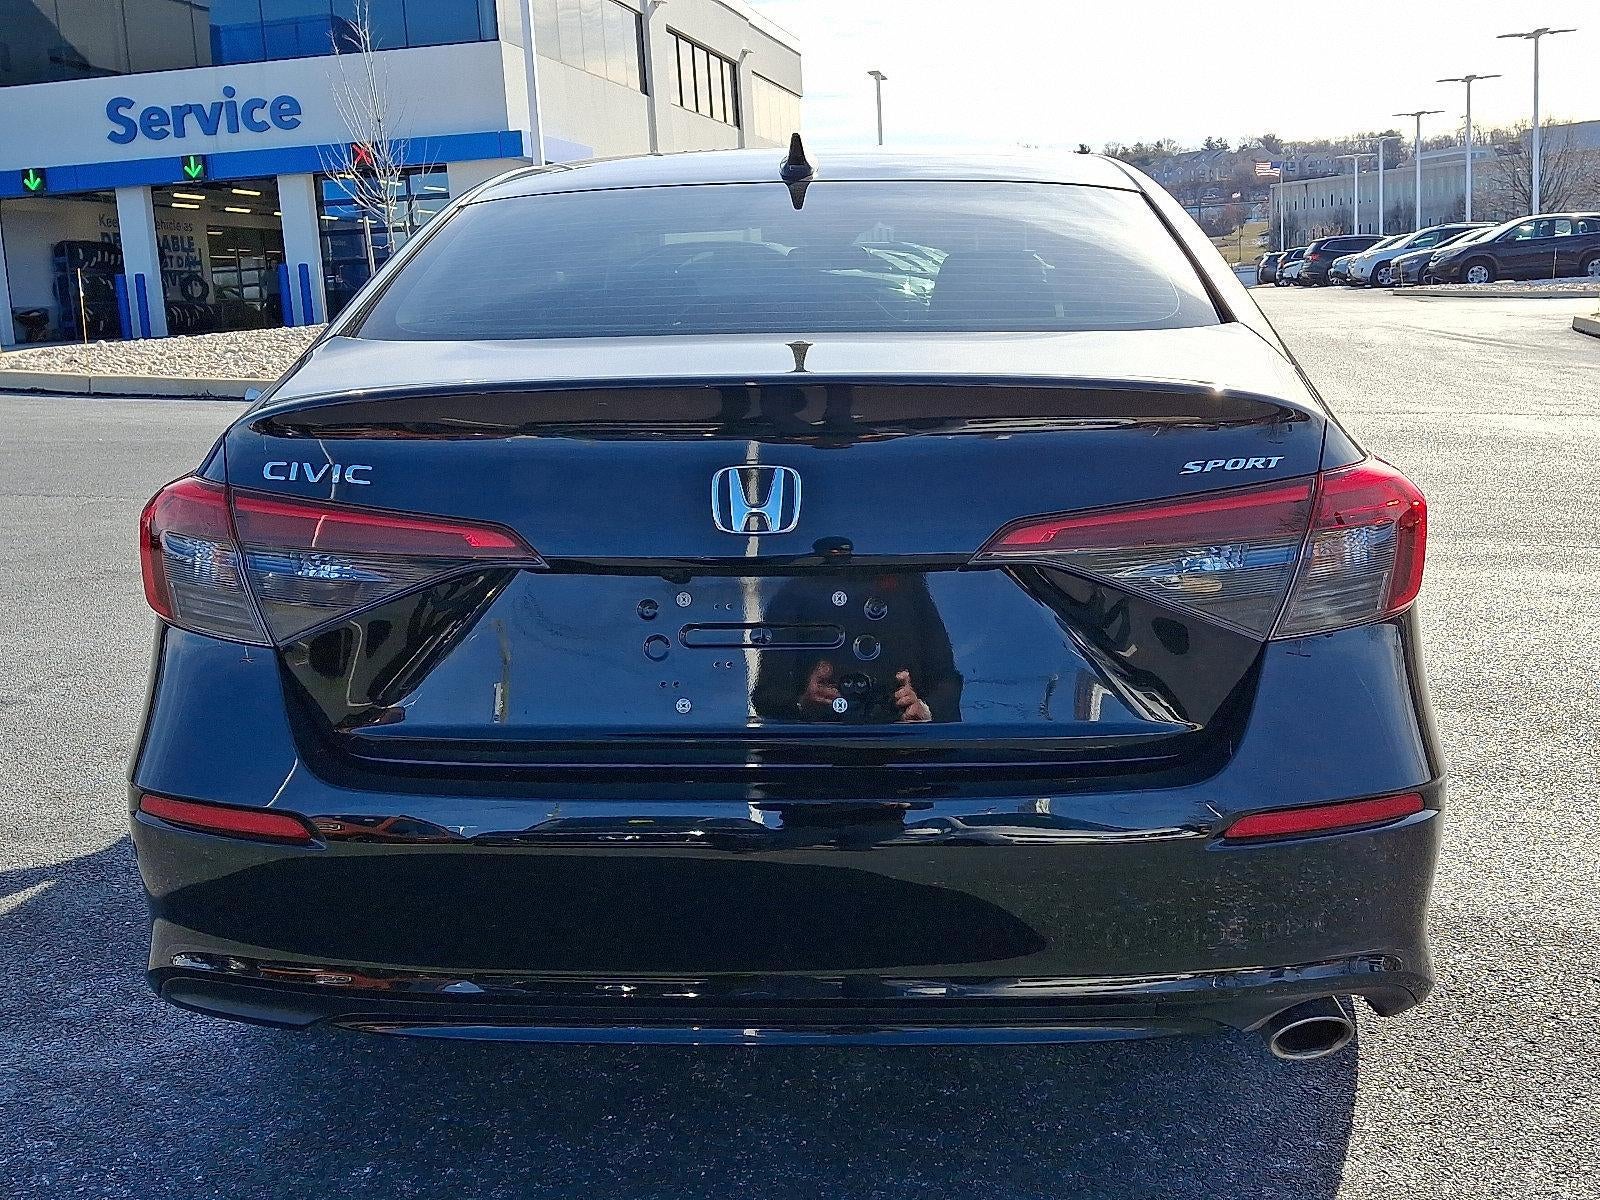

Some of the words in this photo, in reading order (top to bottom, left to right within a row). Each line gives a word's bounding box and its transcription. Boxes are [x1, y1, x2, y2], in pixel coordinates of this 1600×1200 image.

[106, 86, 301, 144] Service
[262, 461, 373, 485] CIVIC
[1178, 456, 1285, 475] SPORT
